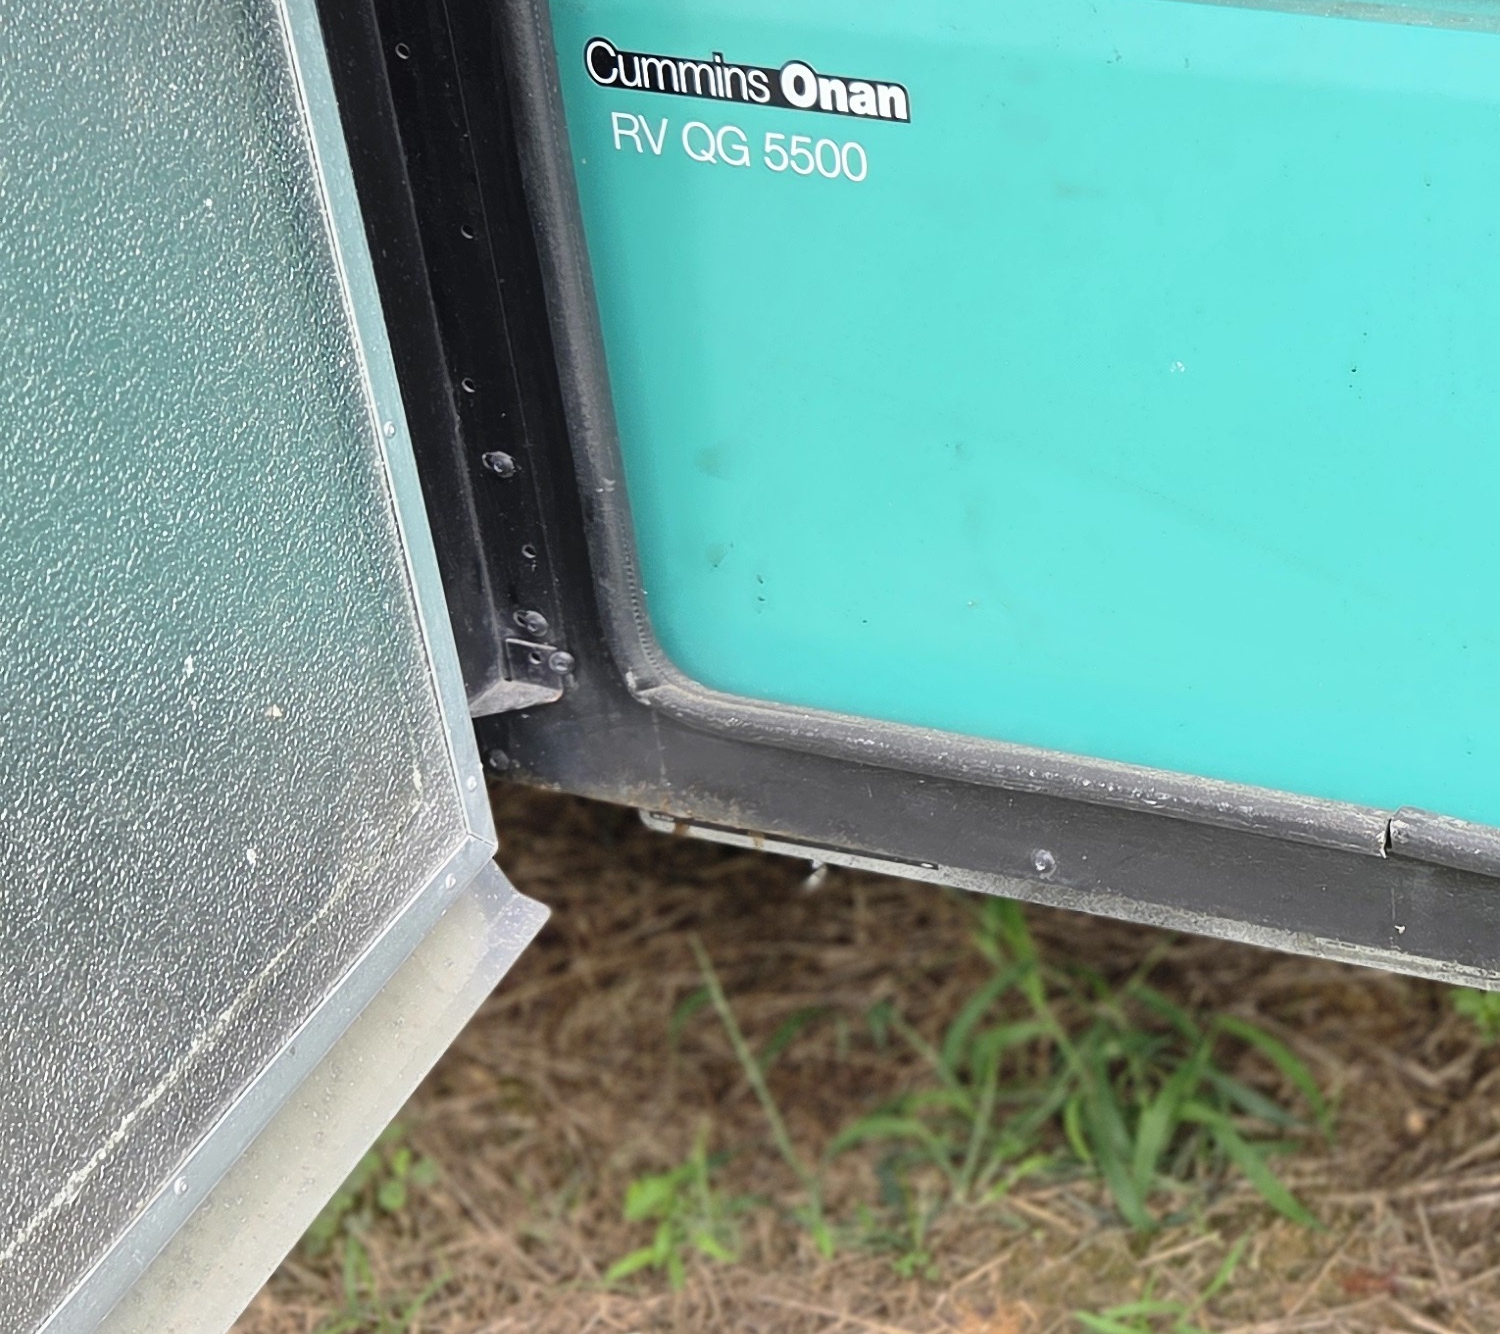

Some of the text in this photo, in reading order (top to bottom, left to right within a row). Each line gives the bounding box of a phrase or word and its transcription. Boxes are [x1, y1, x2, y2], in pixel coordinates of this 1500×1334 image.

[586, 41, 908, 120] Cummins Onan
[611, 112, 868, 182] RV QG 5500
